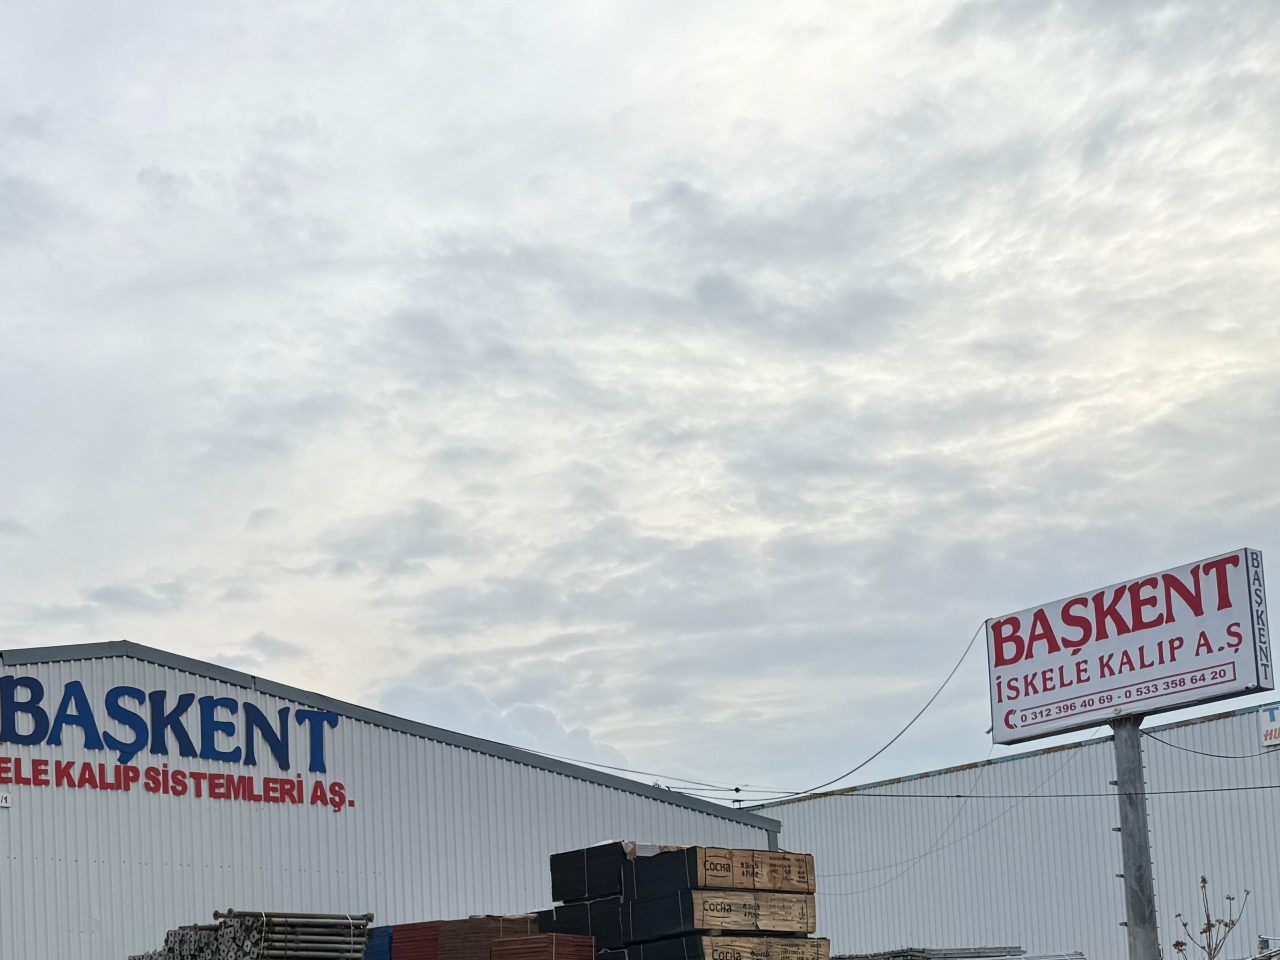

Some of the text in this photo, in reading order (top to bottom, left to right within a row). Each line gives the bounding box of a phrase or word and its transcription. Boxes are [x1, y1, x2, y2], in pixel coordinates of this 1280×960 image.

[991, 554, 1240, 668] BAŞKENT
[1251, 552, 1269, 680] BAŞKENT
[996, 622, 1243, 703] İSKELE KALIP A.Ş
[1021, 714, 1028, 723] 0
[1031, 708, 1052, 721] 312
[1055, 702, 1076, 715] 396
[1080, 698, 1095, 709] 40
[1098, 694, 1113, 704] 69
[1124, 690, 1132, 699] 0
[1136, 684, 1159, 698] 533
[1163, 678, 1186, 691] 358
[1190, 673, 1206, 684] 64
[1210, 668, 1227, 680] 20
[55, 760, 141, 791] KALIP
[144, 763, 304, 804] SİSTEMLERİ
